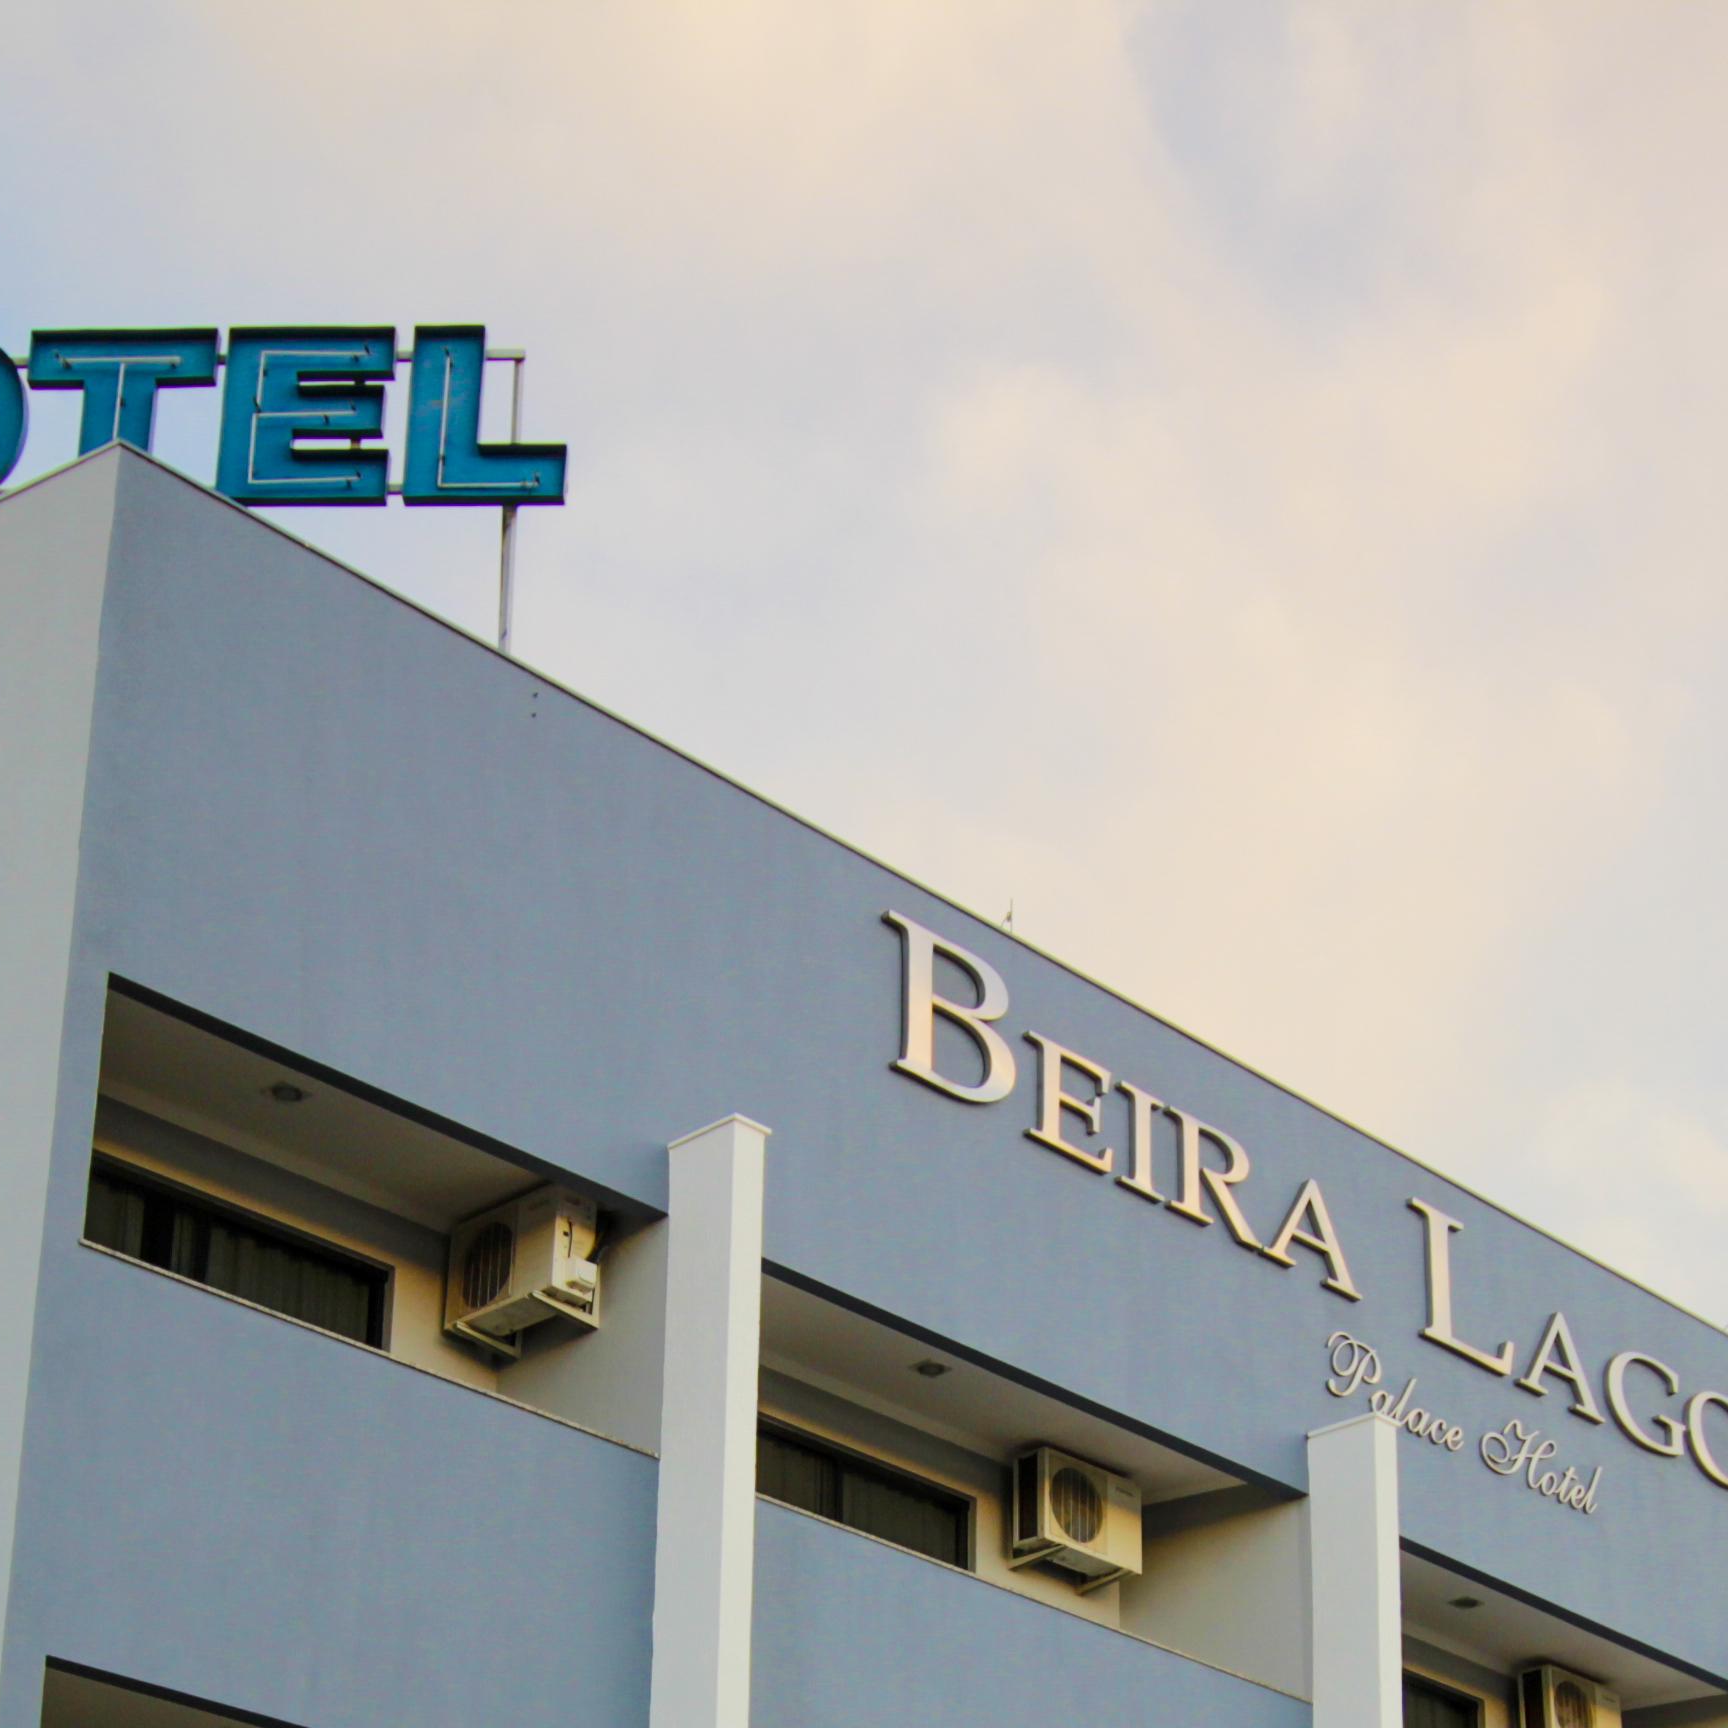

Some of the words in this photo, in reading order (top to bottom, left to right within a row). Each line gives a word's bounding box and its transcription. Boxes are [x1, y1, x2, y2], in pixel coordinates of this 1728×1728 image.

[881, 908, 1364, 1303] BEIRA
[1326, 1331, 1465, 1452] Palace
[1479, 1418, 1603, 1515] Hotel
